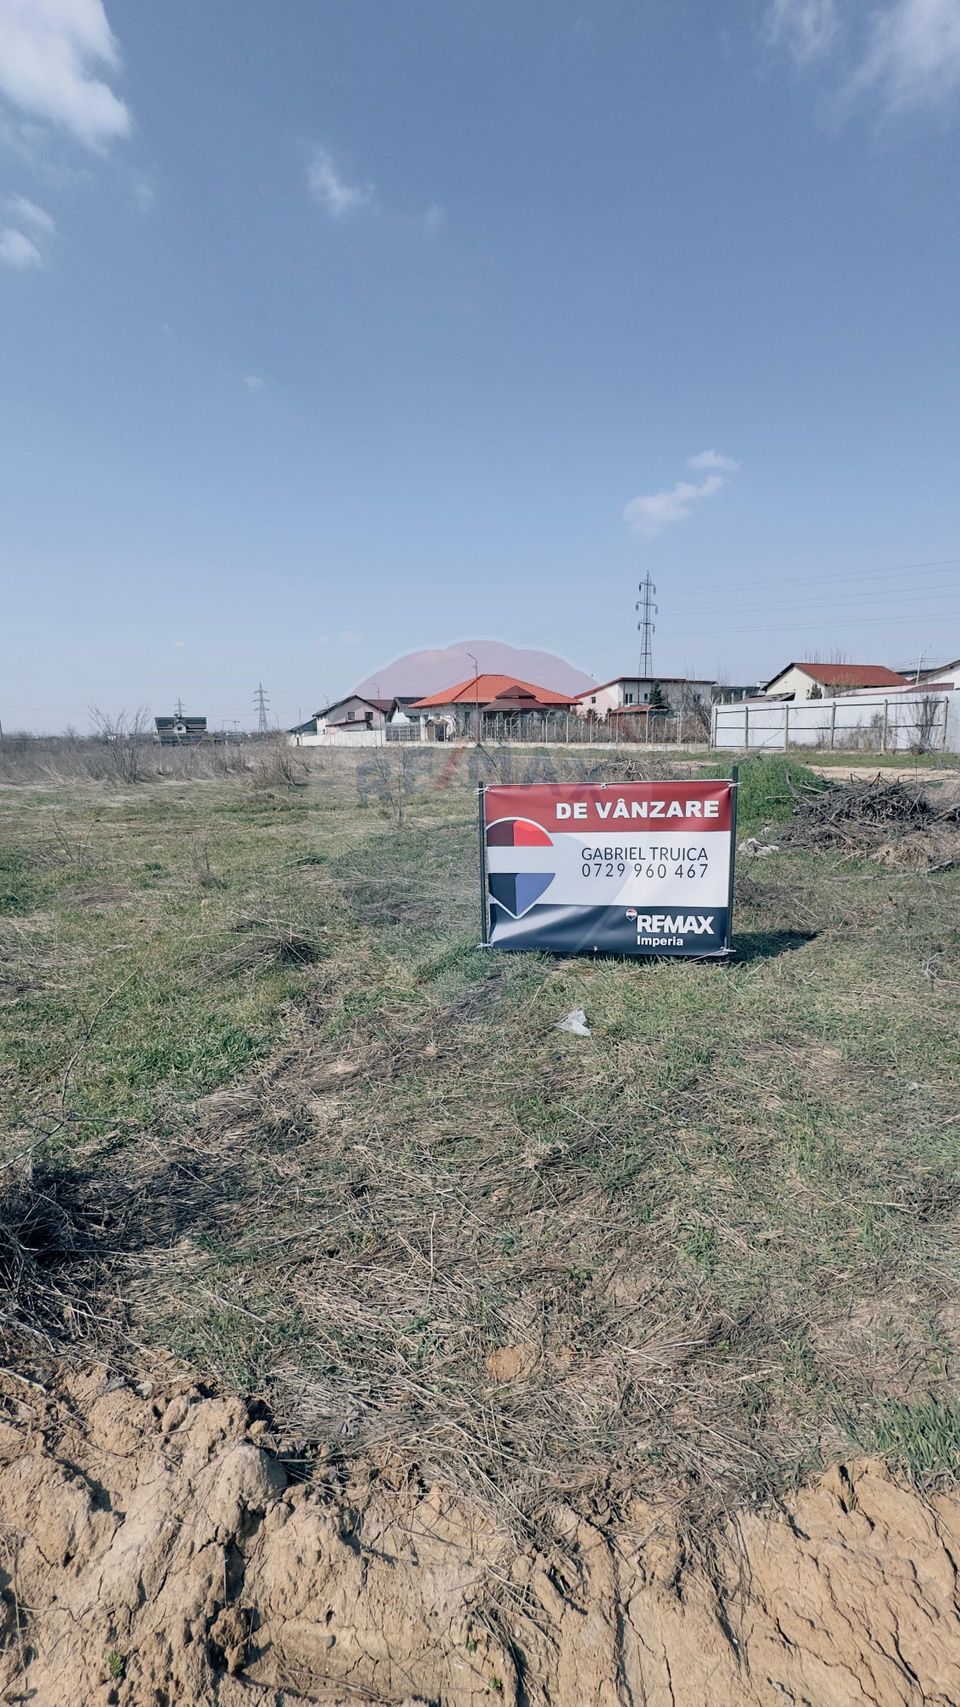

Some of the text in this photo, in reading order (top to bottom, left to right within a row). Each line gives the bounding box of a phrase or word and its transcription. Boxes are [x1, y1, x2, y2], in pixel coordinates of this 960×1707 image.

[555, 798, 720, 819] DE VÂNZARE
[581, 846, 709, 862] GABRIEL TRUICA
[581, 862, 709, 879] 0729 960 467
[636, 935, 684, 947] Imperia
